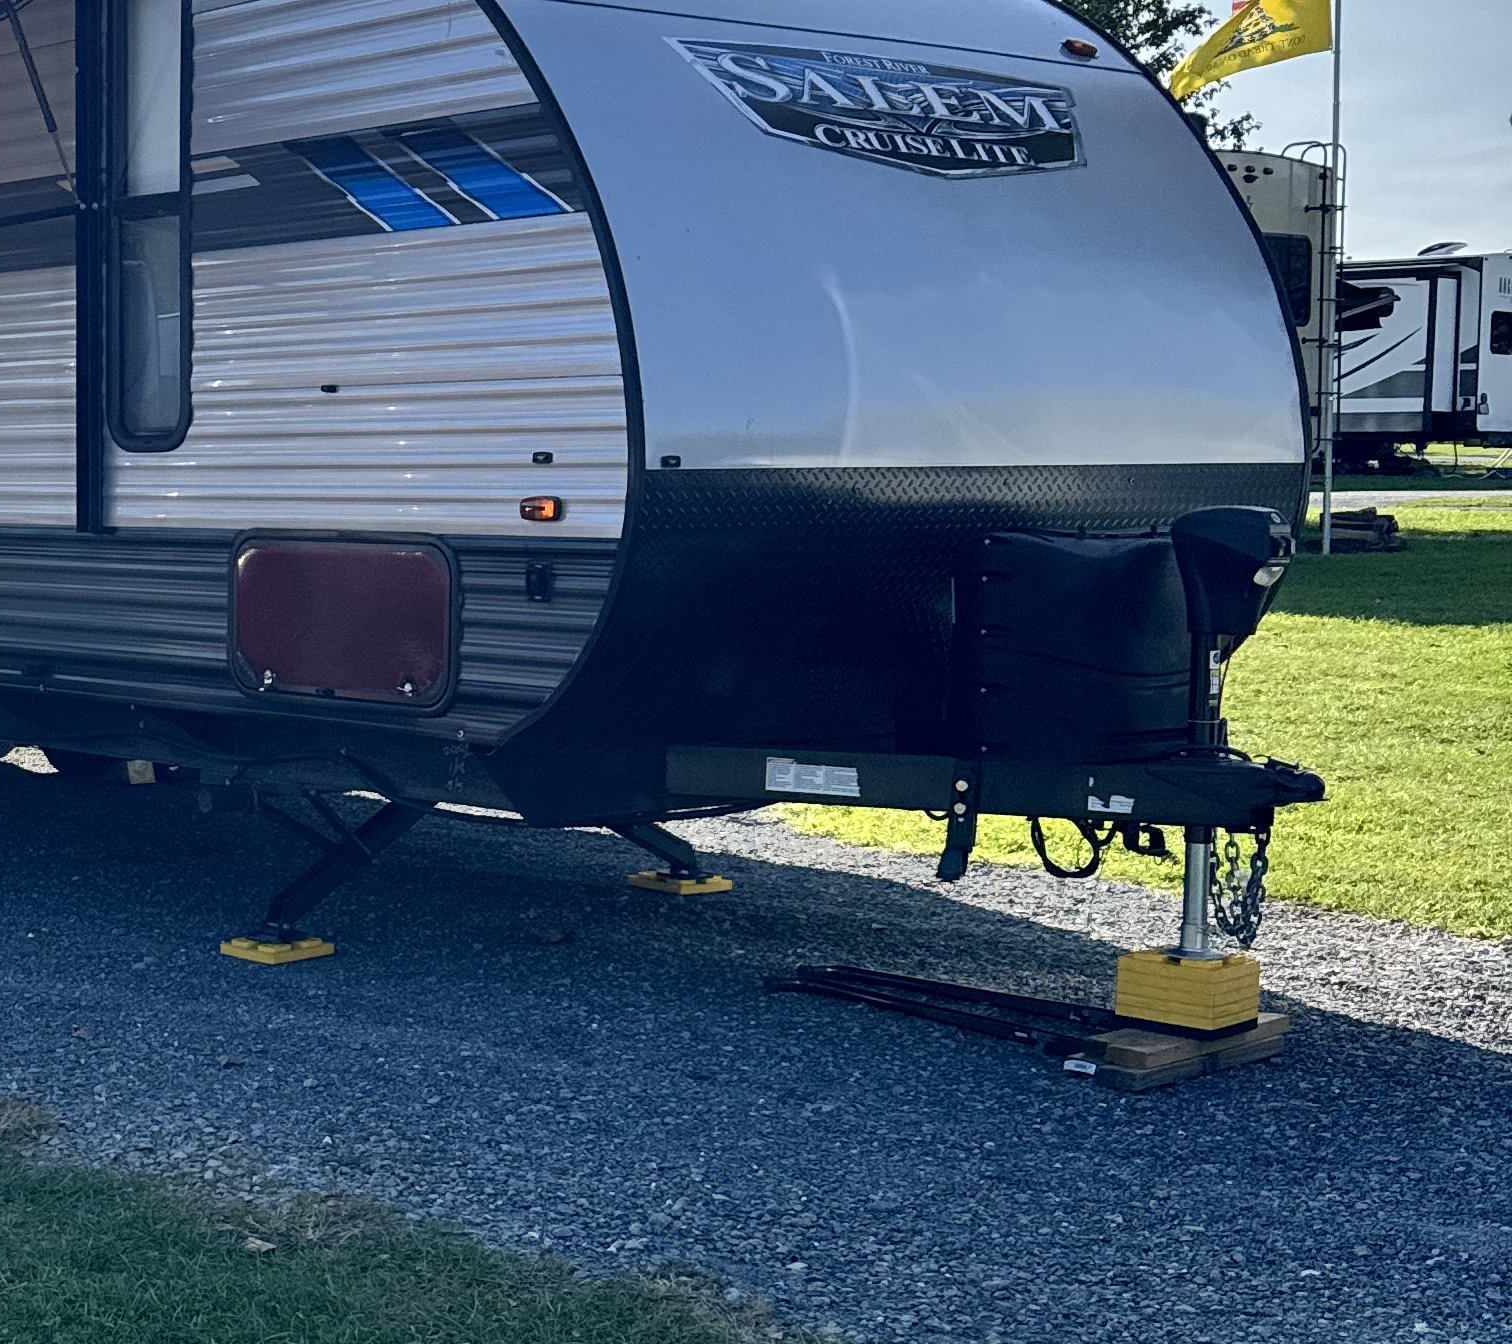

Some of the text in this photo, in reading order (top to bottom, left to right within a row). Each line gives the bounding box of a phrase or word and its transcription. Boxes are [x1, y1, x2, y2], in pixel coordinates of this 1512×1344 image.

[820, 51, 930, 76] FOREST RIVER
[717, 52, 1072, 133] SALEM
